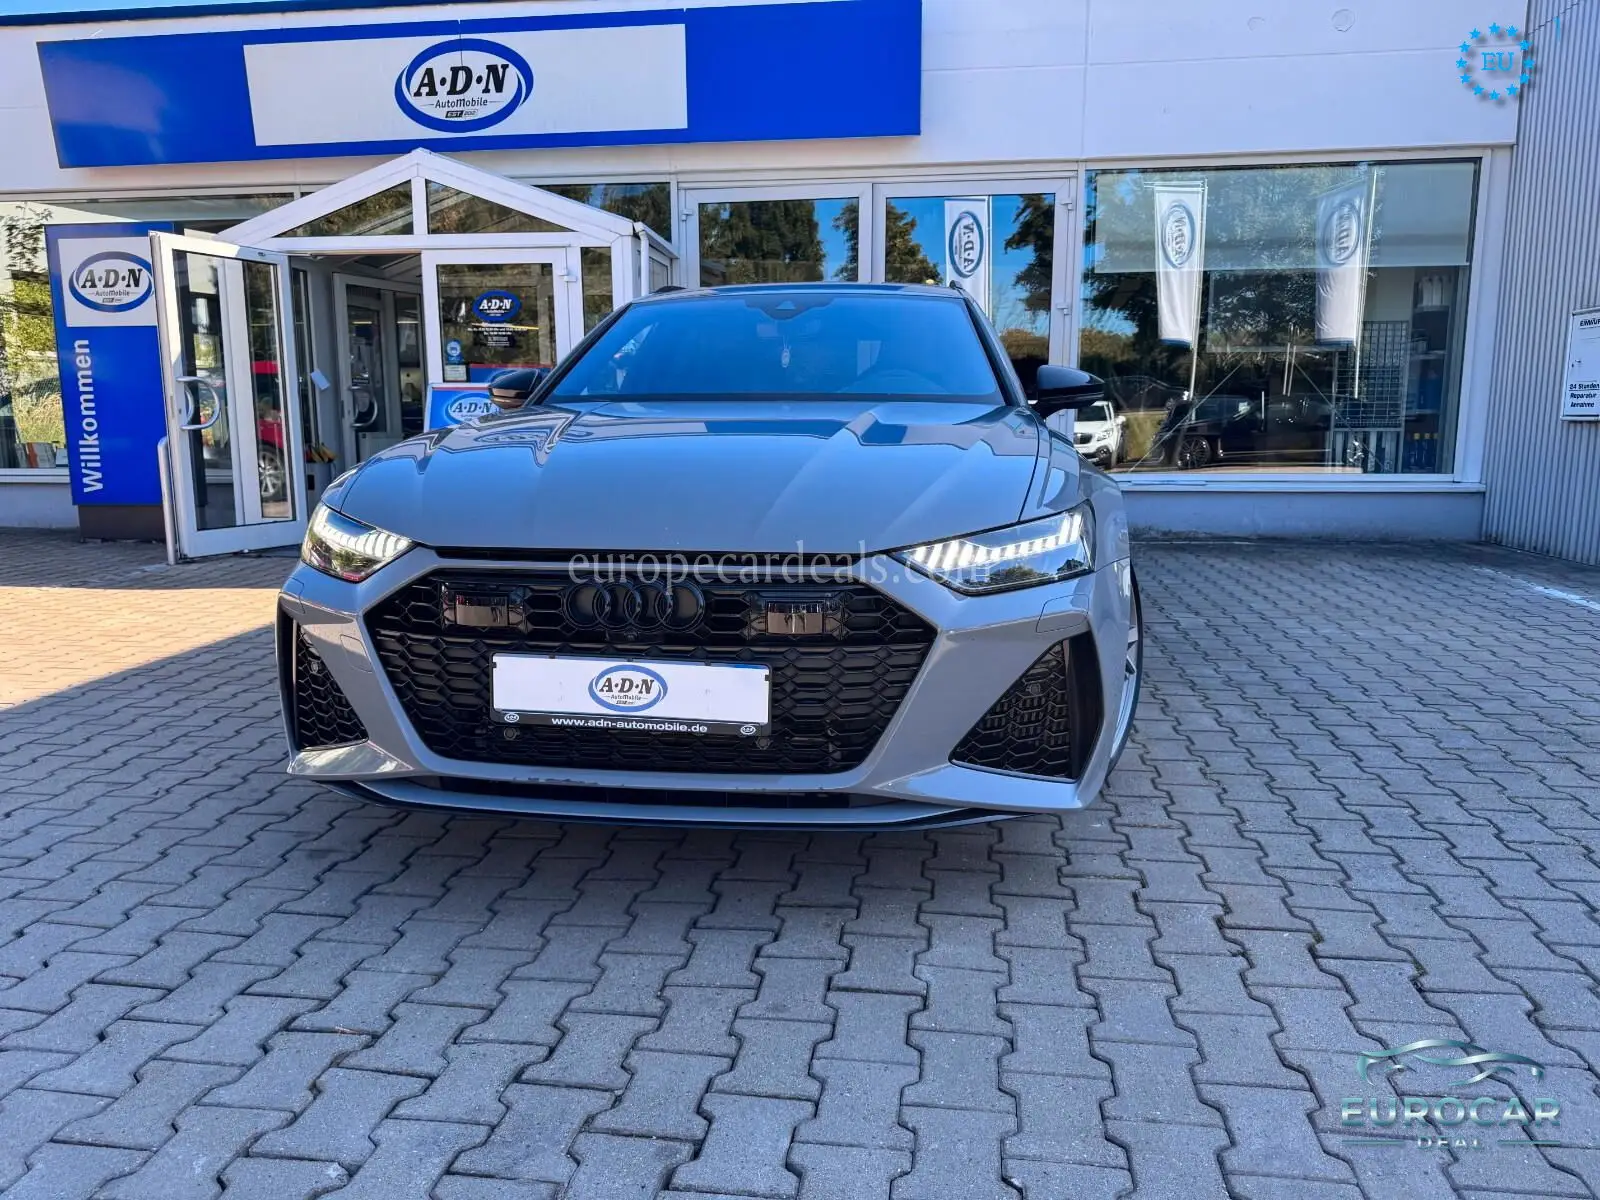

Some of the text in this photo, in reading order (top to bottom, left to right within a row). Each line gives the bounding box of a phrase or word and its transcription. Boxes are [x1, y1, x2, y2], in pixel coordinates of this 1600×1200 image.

[434, 97, 489, 109] AutoMobile
[73, 338, 104, 494] Willkommen
[551, 716, 708, 733] www.adn-automobile.de
